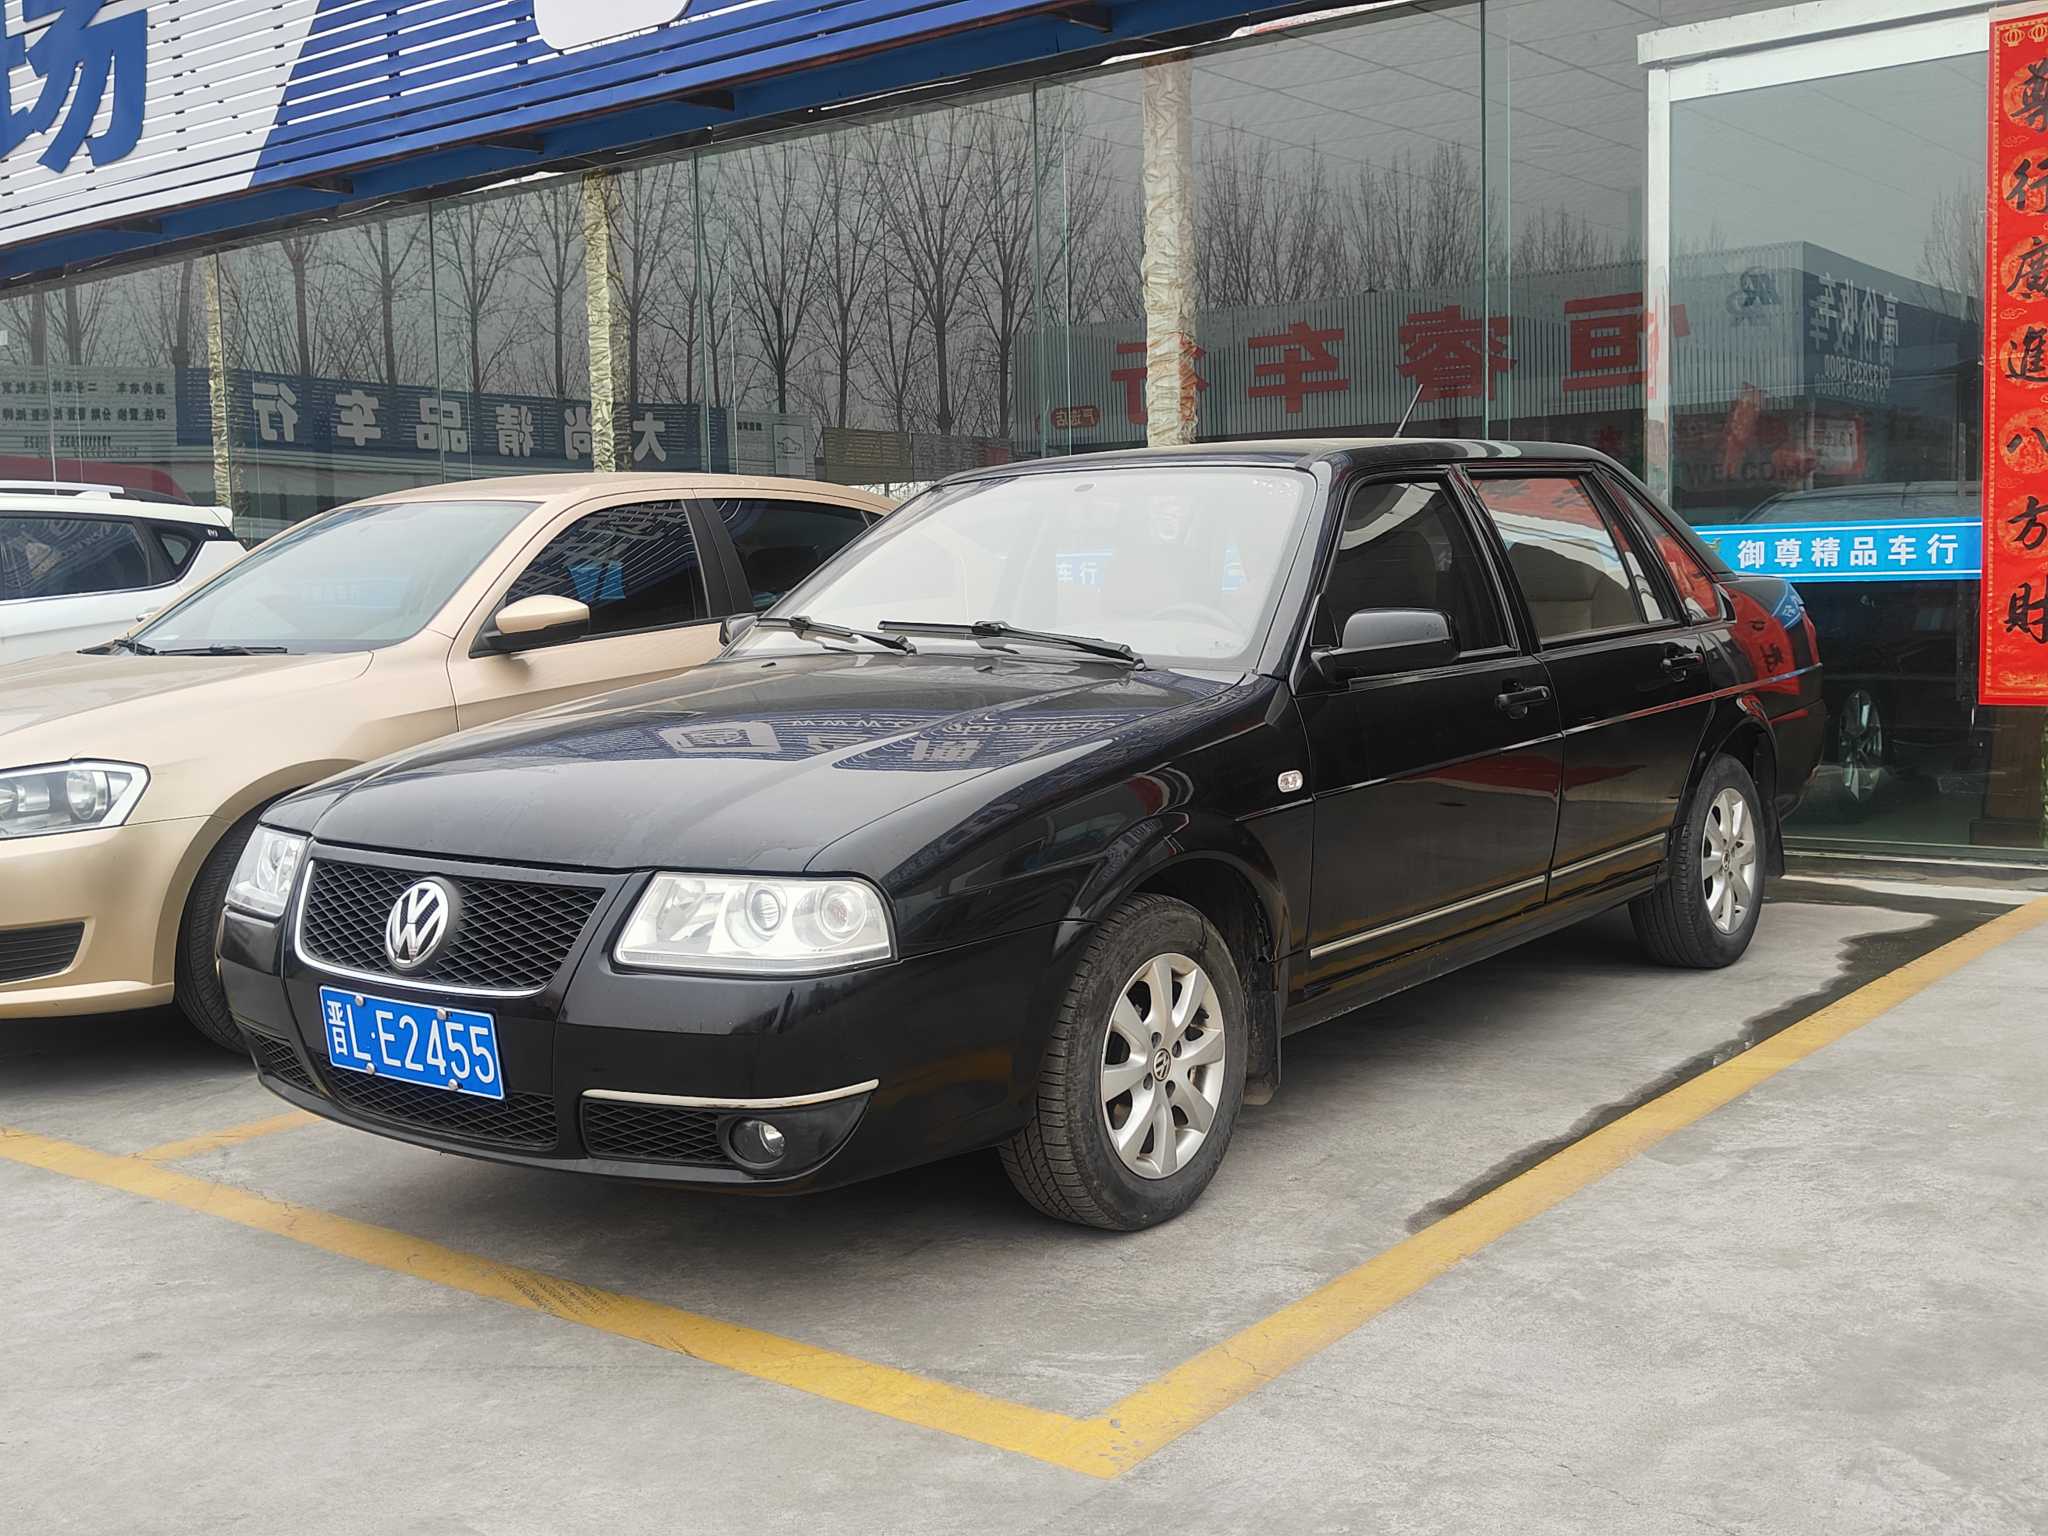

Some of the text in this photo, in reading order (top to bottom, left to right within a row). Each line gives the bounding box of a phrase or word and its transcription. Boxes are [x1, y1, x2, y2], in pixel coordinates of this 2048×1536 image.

[1737, 533, 1959, 569] 御尊精品车行
